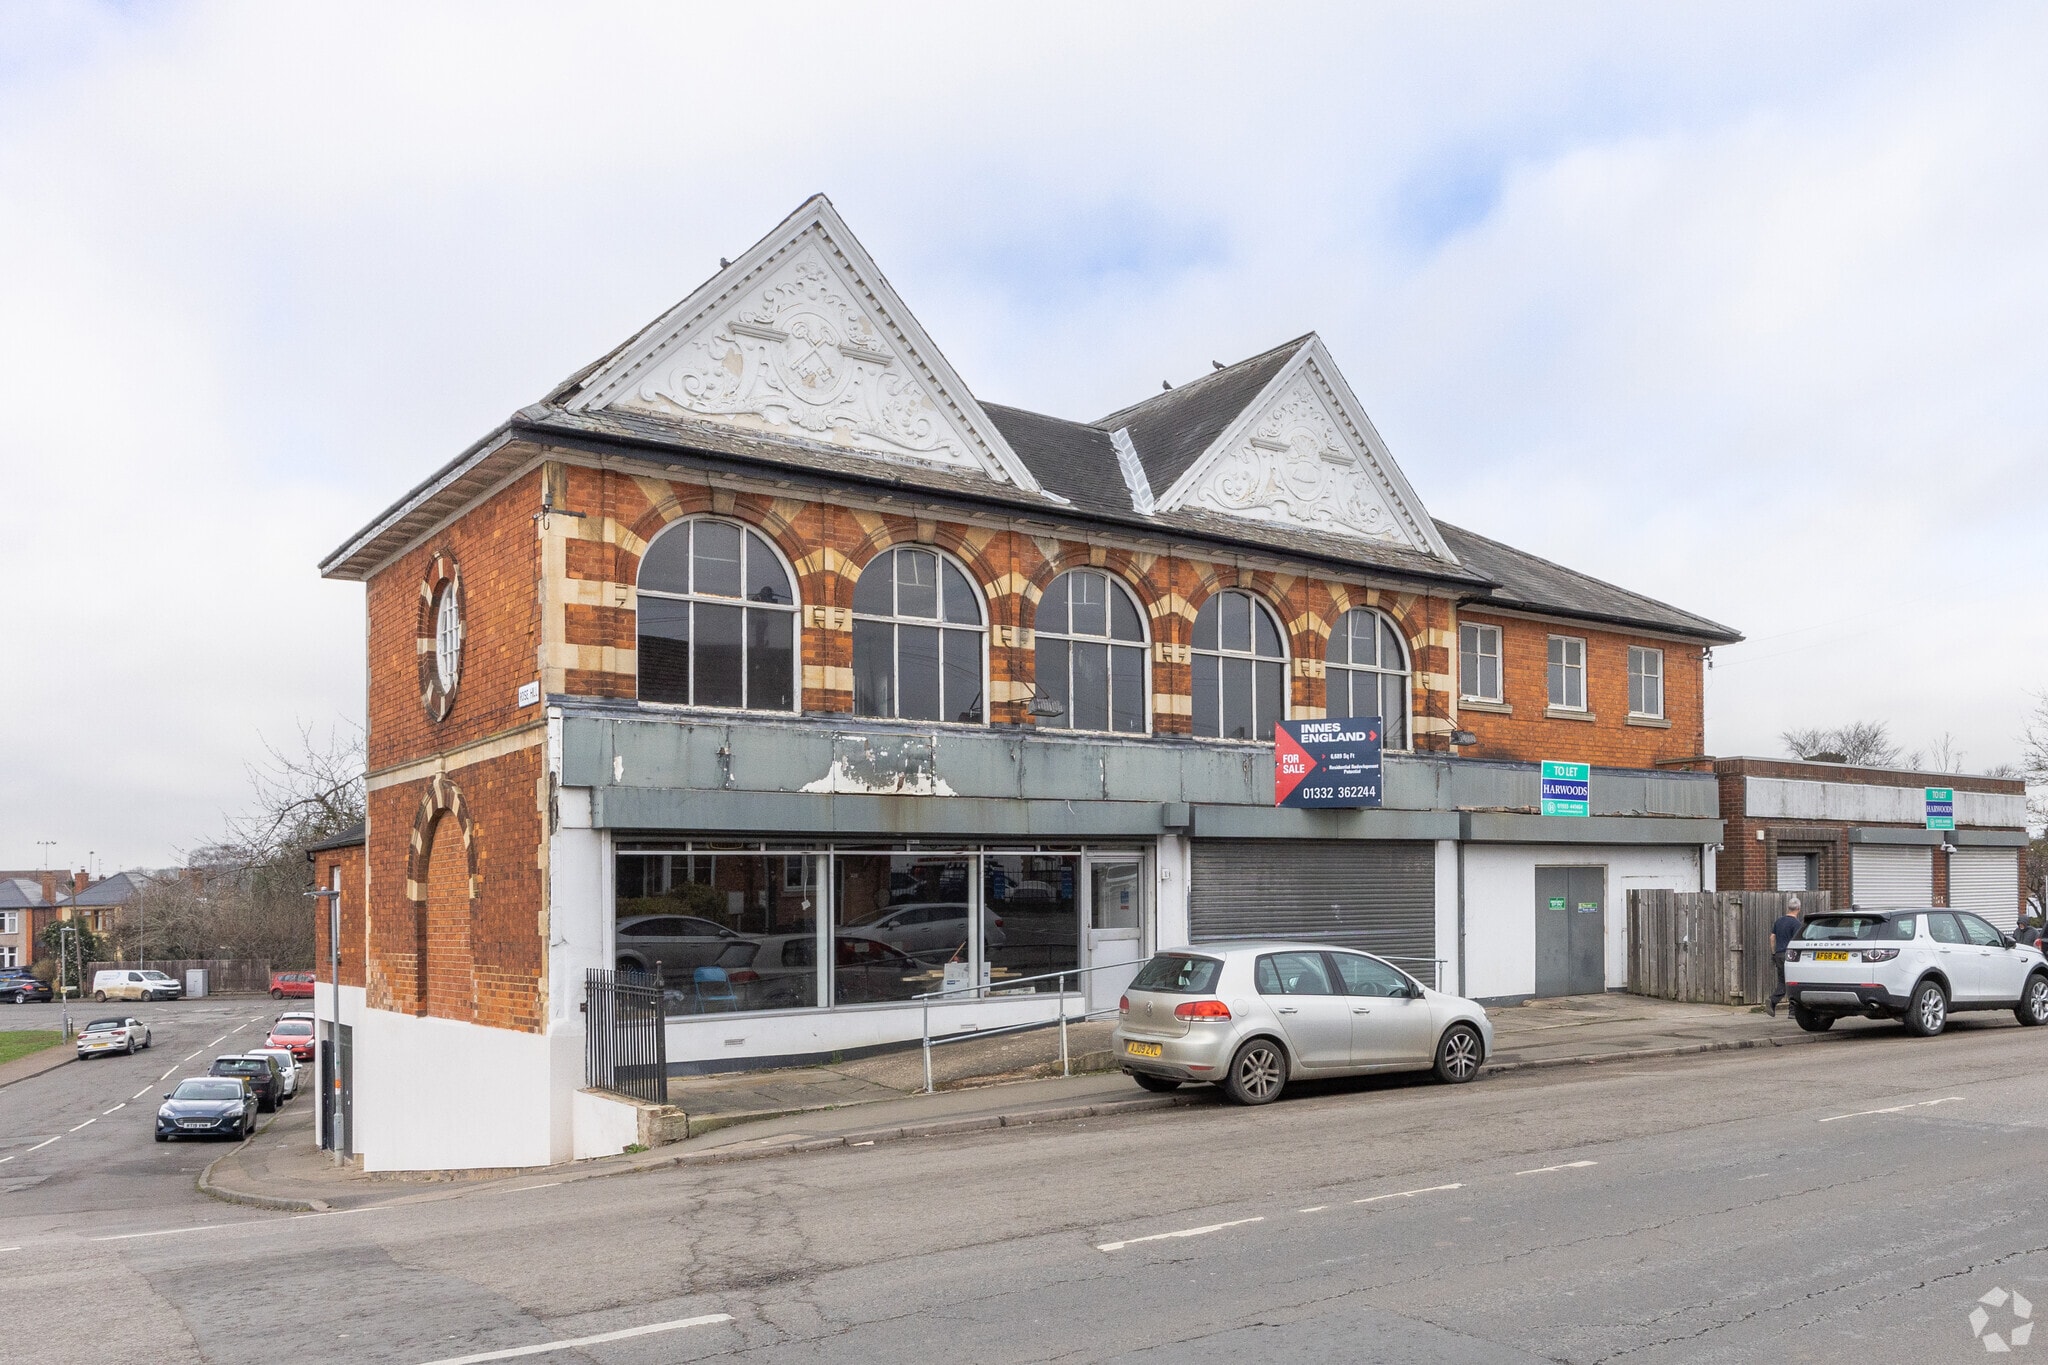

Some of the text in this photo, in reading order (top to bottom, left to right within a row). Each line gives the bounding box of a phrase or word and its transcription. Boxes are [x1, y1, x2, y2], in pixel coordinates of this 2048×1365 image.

[1301, 723, 1341, 733] INNES
[1301, 732, 1366, 743] ENGLAND
[1283, 754, 1299, 764] FOR
[1283, 764, 1305, 774] SALE
[1554, 766, 1578, 776] TO LET
[1303, 786, 1376, 799] 01332 362244
[1543, 784, 1588, 796] HARWOODS
[1932, 791, 1939, 799] TO
[1926, 805, 1953, 813] HARWOODS
[1816, 952, 1832, 960] AF68
[1833, 952, 1847, 960] ZWG
